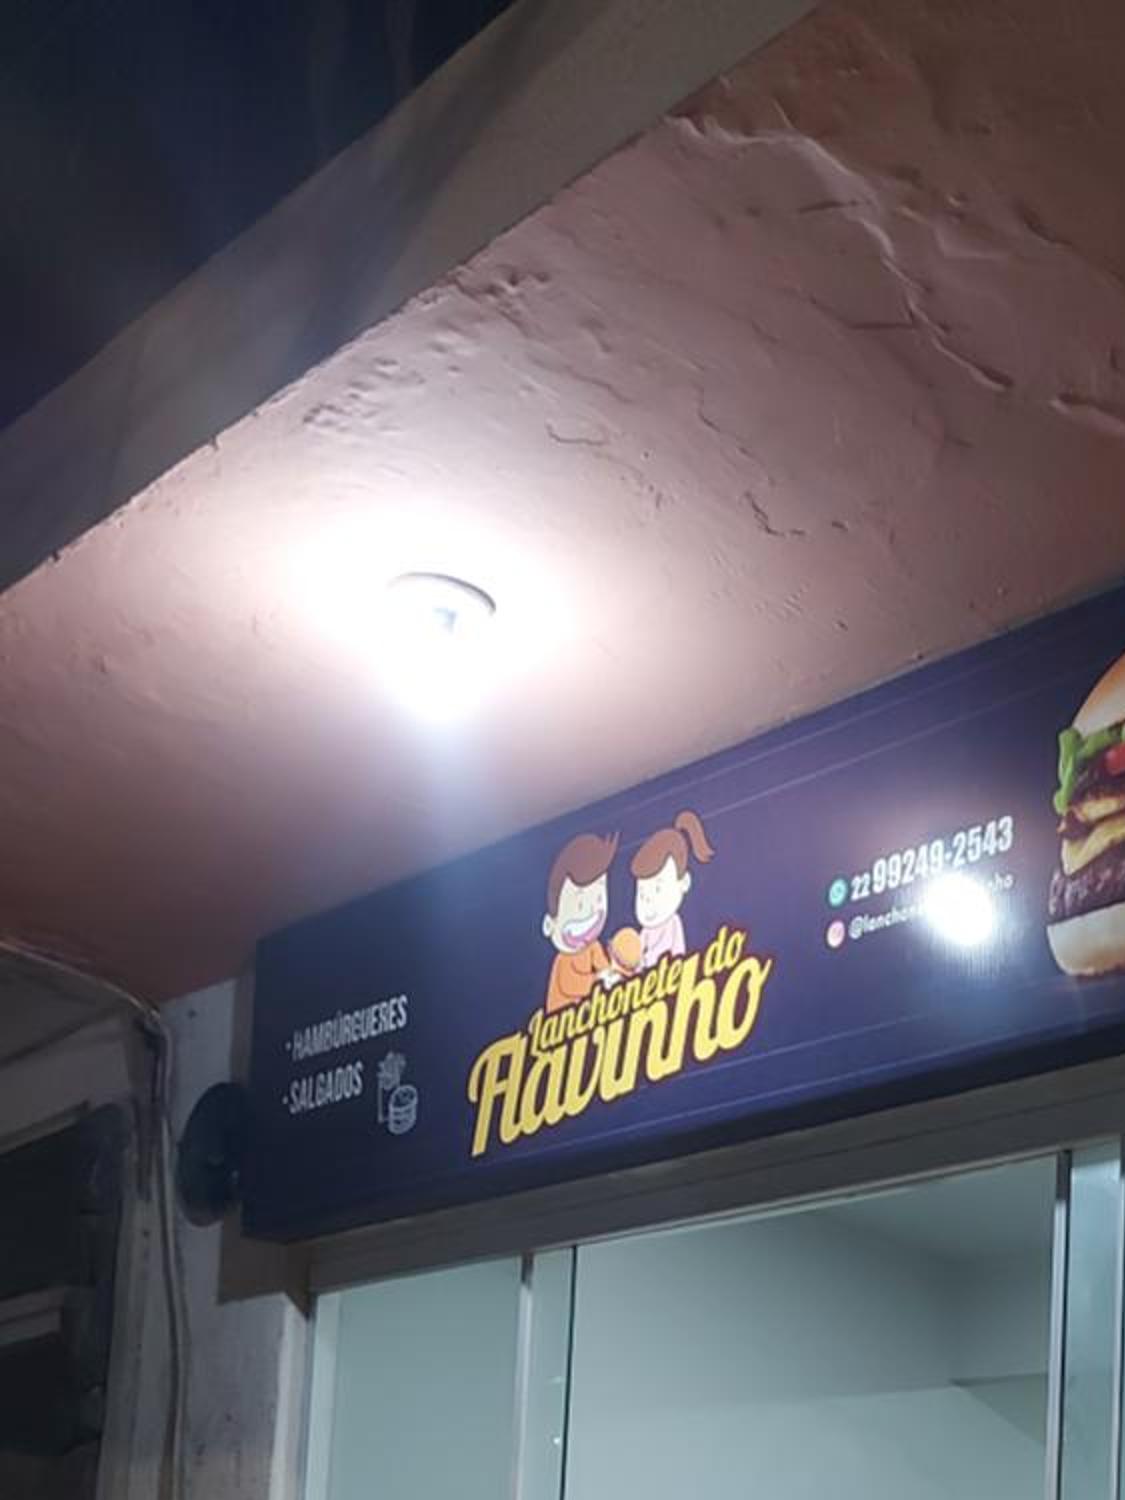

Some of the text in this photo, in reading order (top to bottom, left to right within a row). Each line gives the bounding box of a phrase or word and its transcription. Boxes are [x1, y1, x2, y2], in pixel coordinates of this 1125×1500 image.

[850, 875, 871, 901] 22
[703, 926, 748, 980] do
[292, 995, 409, 1061] HAMBÚRGUERES
[467, 956, 774, 1157] Flavinho
[288, 1062, 364, 1114] SALGADOS
